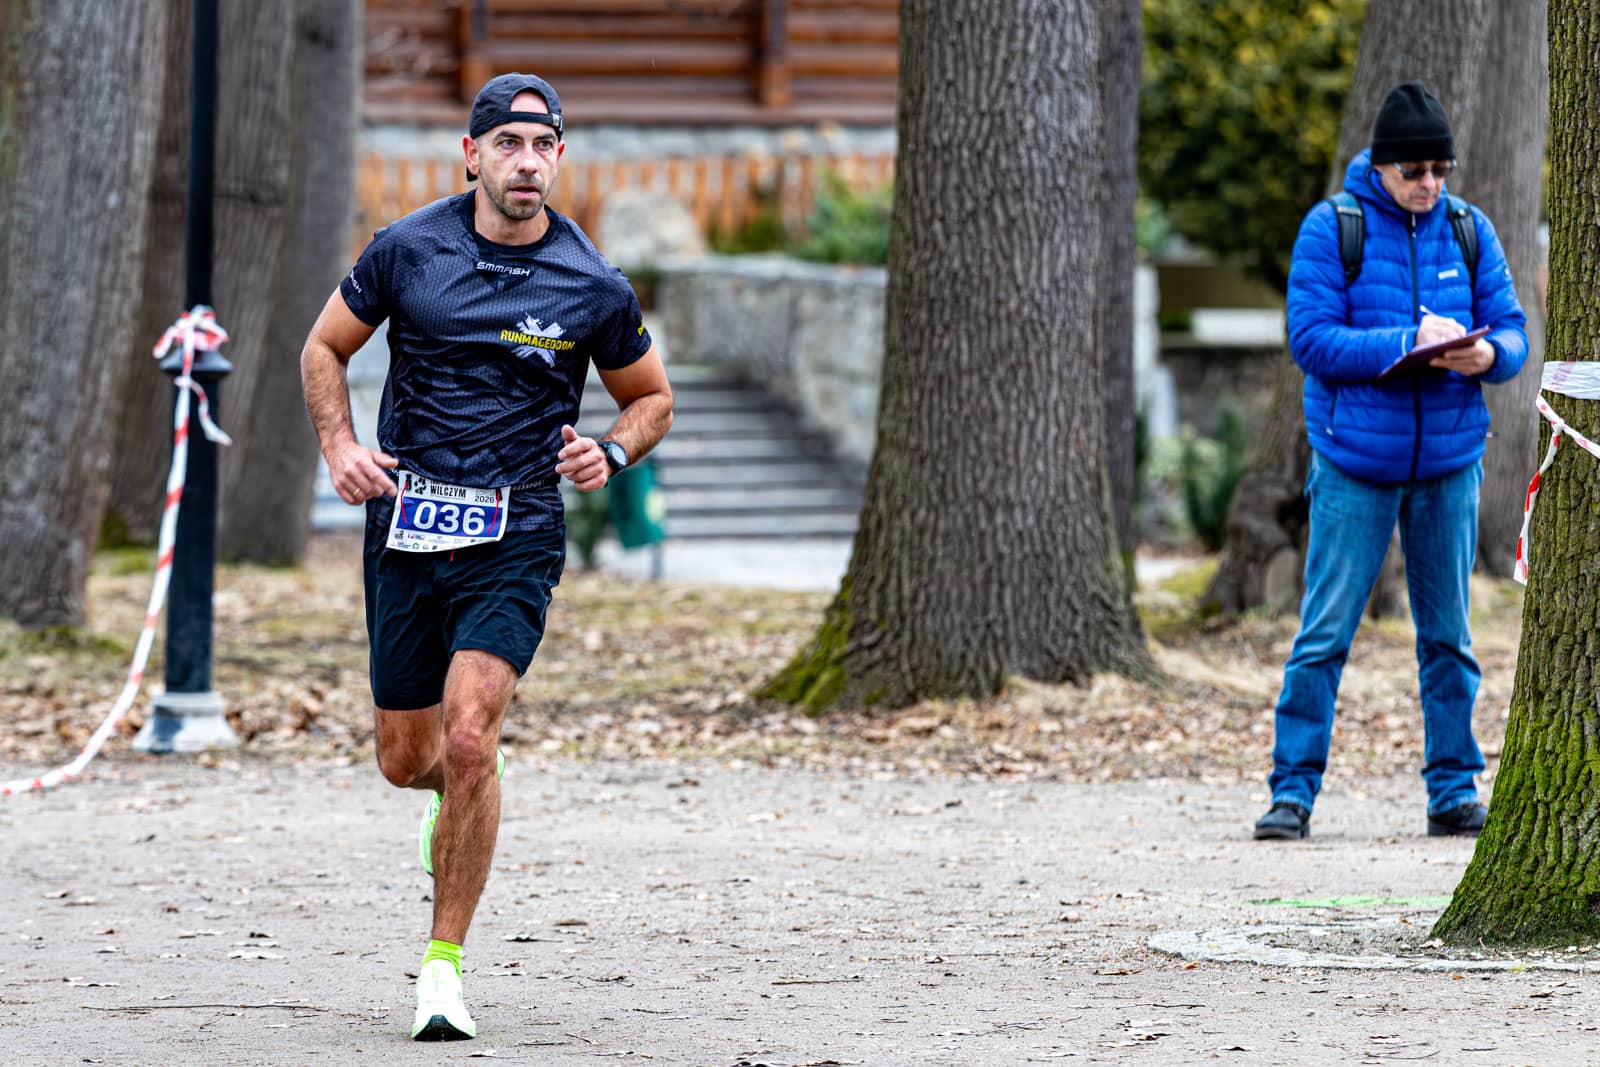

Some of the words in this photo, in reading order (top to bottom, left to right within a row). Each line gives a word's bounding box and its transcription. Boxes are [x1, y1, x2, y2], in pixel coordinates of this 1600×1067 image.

[476, 261, 531, 276] SMMASH
[500, 329, 576, 351] RUNMAGEDDON
[430, 485, 466, 499] WILCZYM
[474, 495, 495, 504] 2026
[413, 500, 486, 536] 036
